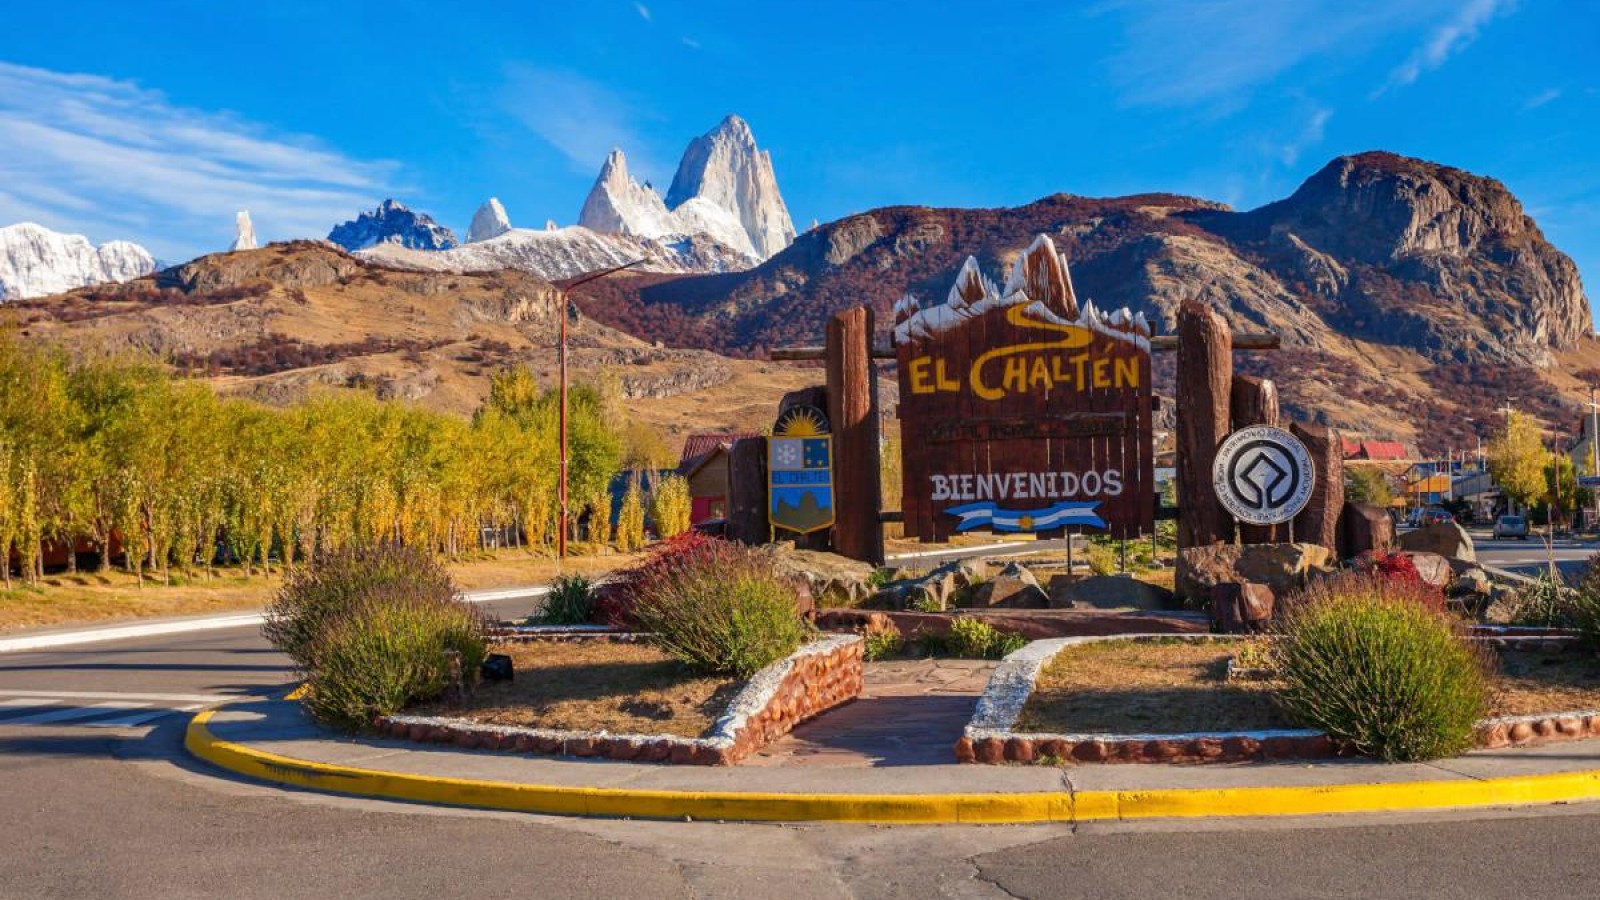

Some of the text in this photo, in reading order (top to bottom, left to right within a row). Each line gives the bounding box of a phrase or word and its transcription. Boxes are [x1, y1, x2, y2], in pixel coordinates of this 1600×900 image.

[908, 342, 1140, 400] EL CHALTÉN
[929, 469, 1123, 501] BIENVENIDOS
